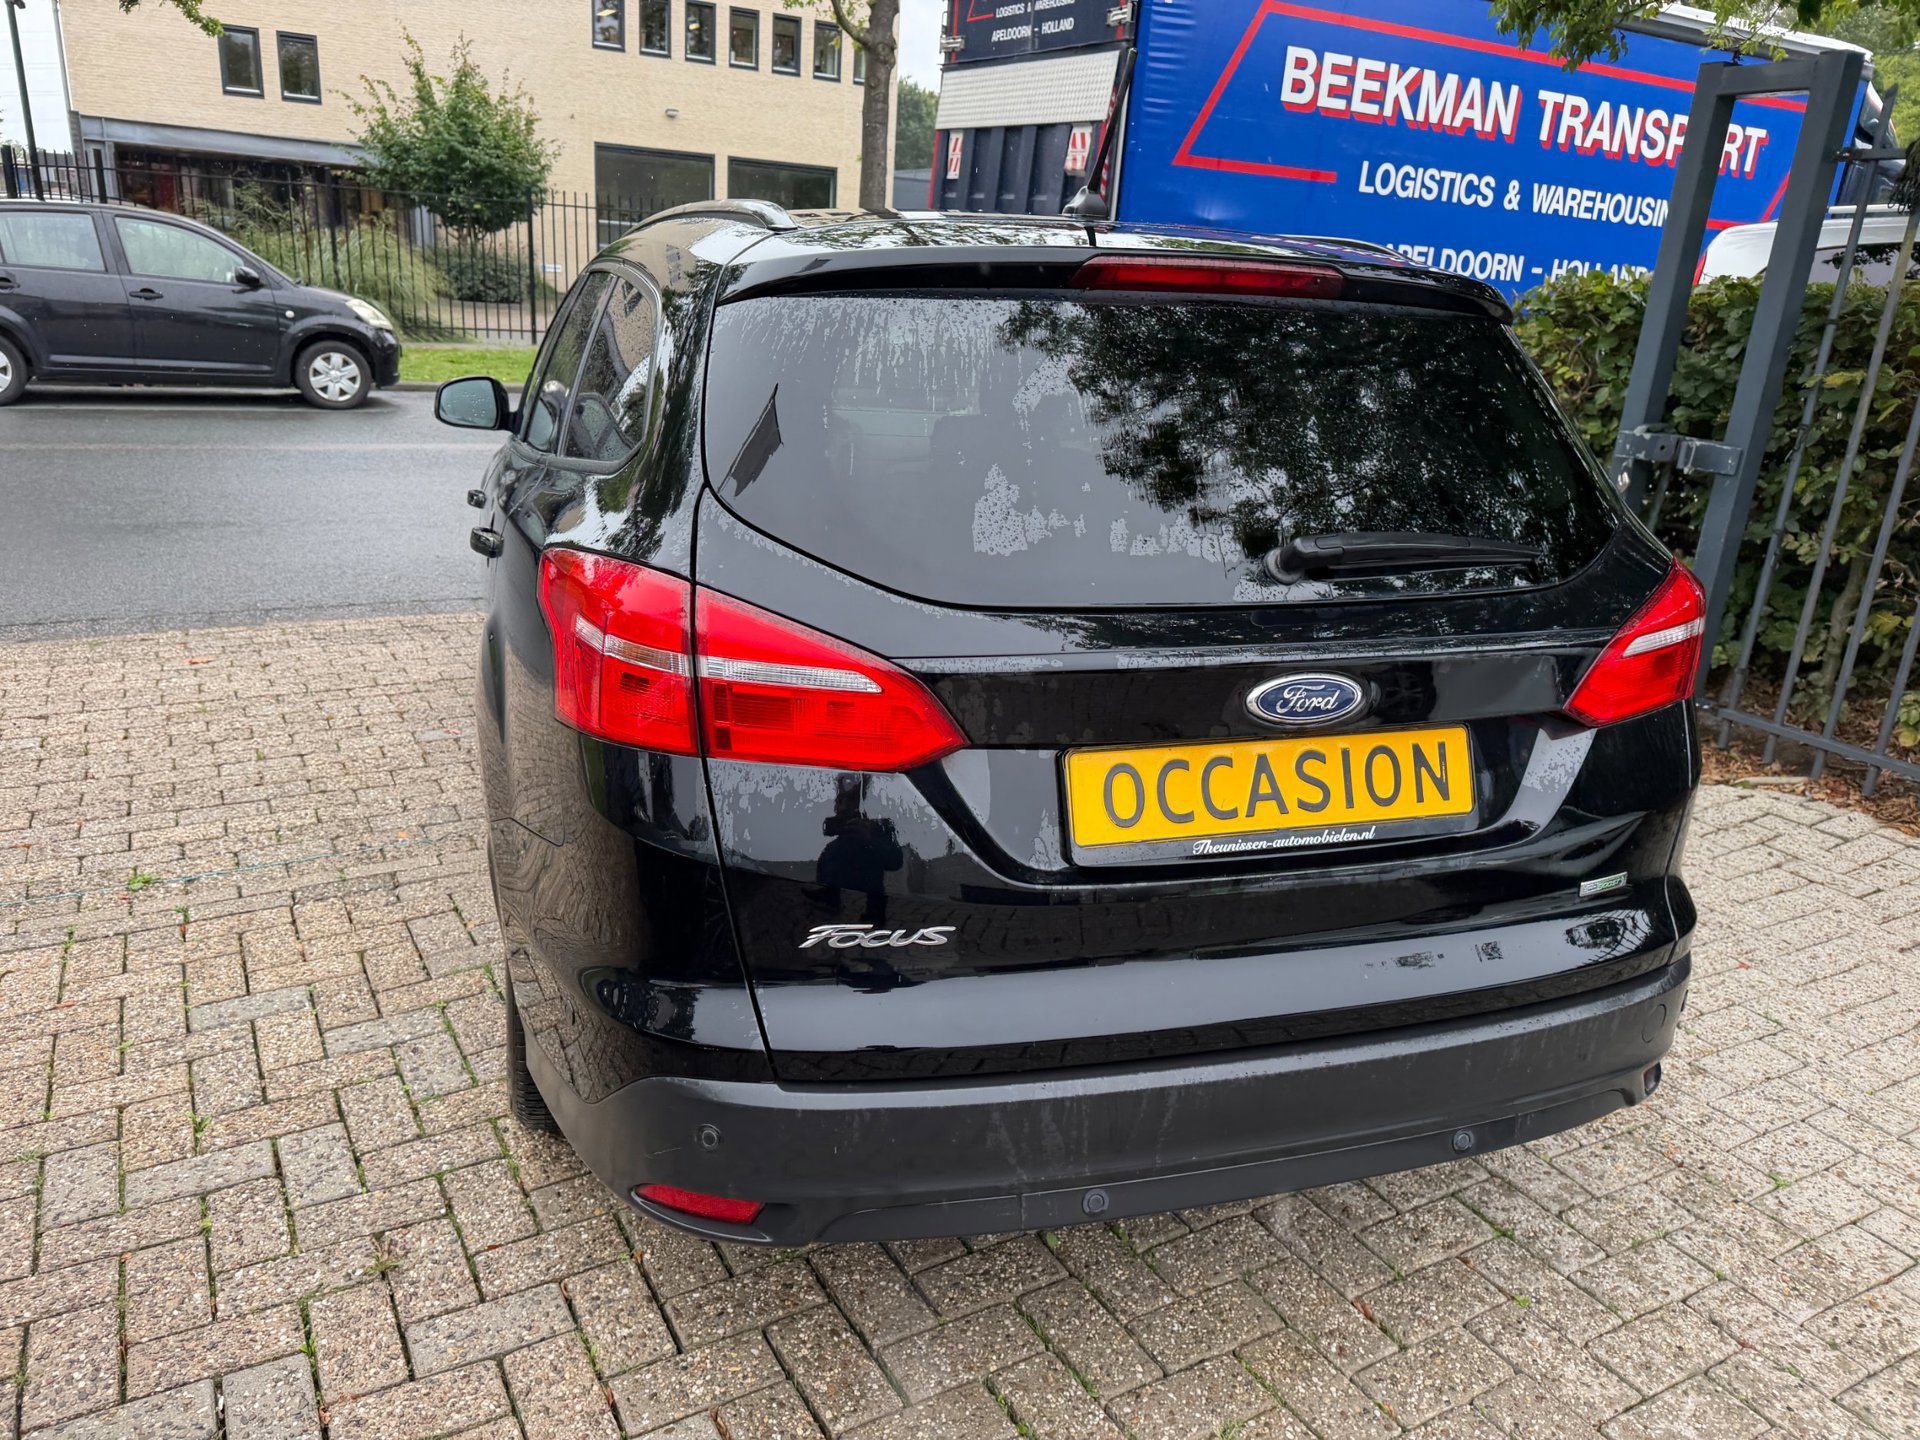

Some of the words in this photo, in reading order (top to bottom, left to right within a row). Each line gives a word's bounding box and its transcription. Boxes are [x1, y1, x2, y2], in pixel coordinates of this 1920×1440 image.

[995, 4, 1025, 18] LOGISTICS
[991, 25, 1032, 43] APELDOORN
[1041, 17, 1074, 35] HOLLAND
[1280, 45, 1523, 144] BEEKMAN
[1537, 90, 1770, 180] TRANSPRT
[1358, 160, 1495, 207] LOGISTICS
[1503, 179, 1521, 211] &
[1532, 182, 1669, 227] WAREHOUSIN
[1386, 243, 1524, 282] ELDOORN
[1531, 266, 1543, 275] -
[1276, 684, 1340, 714] Ford
[1103, 742, 1450, 828] OCCASION
[1193, 825, 1376, 855] Theunissen-automobielen.nl
